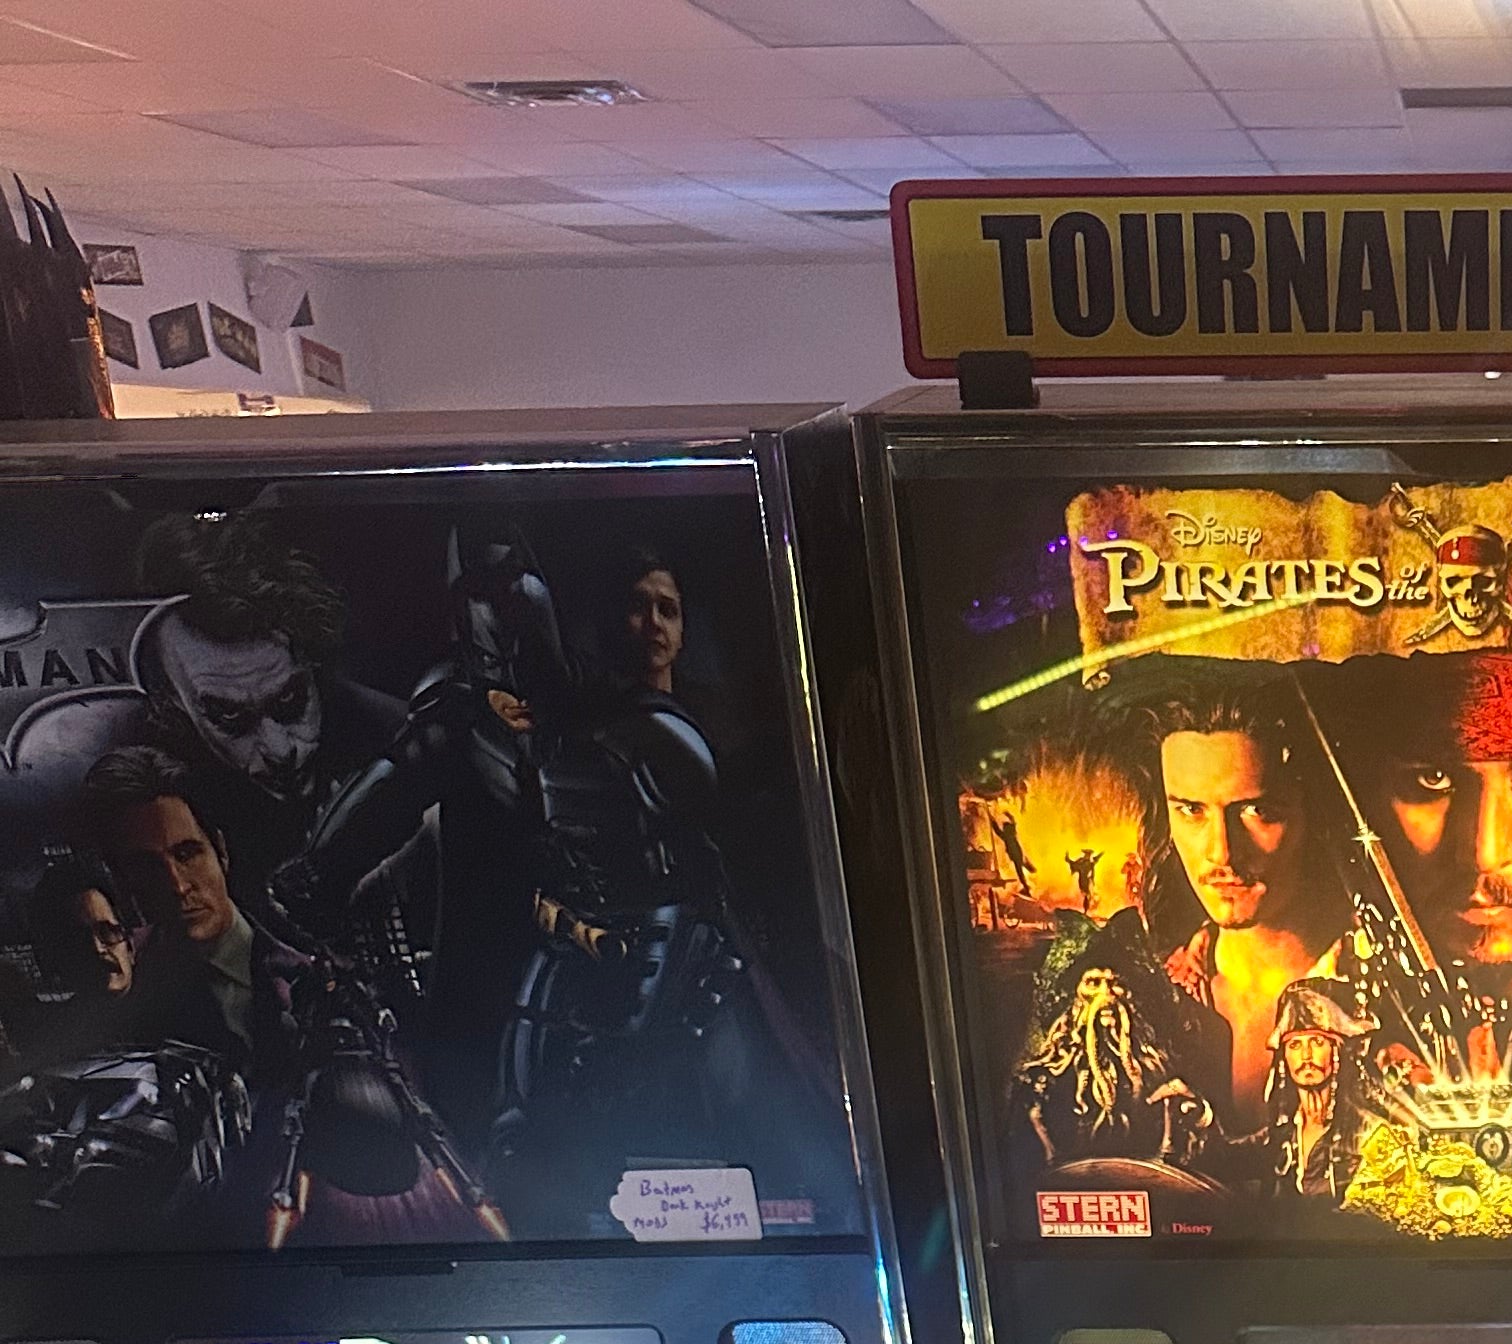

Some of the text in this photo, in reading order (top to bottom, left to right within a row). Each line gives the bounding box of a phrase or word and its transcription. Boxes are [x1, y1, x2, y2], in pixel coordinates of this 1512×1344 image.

[1083, 539, 1384, 614] PIRATES
[1400, 560, 1428, 584] of
[1386, 579, 1430, 601] the
[1041, 1195, 1146, 1223] STERN
[1172, 1222, 1213, 1236] Disney
